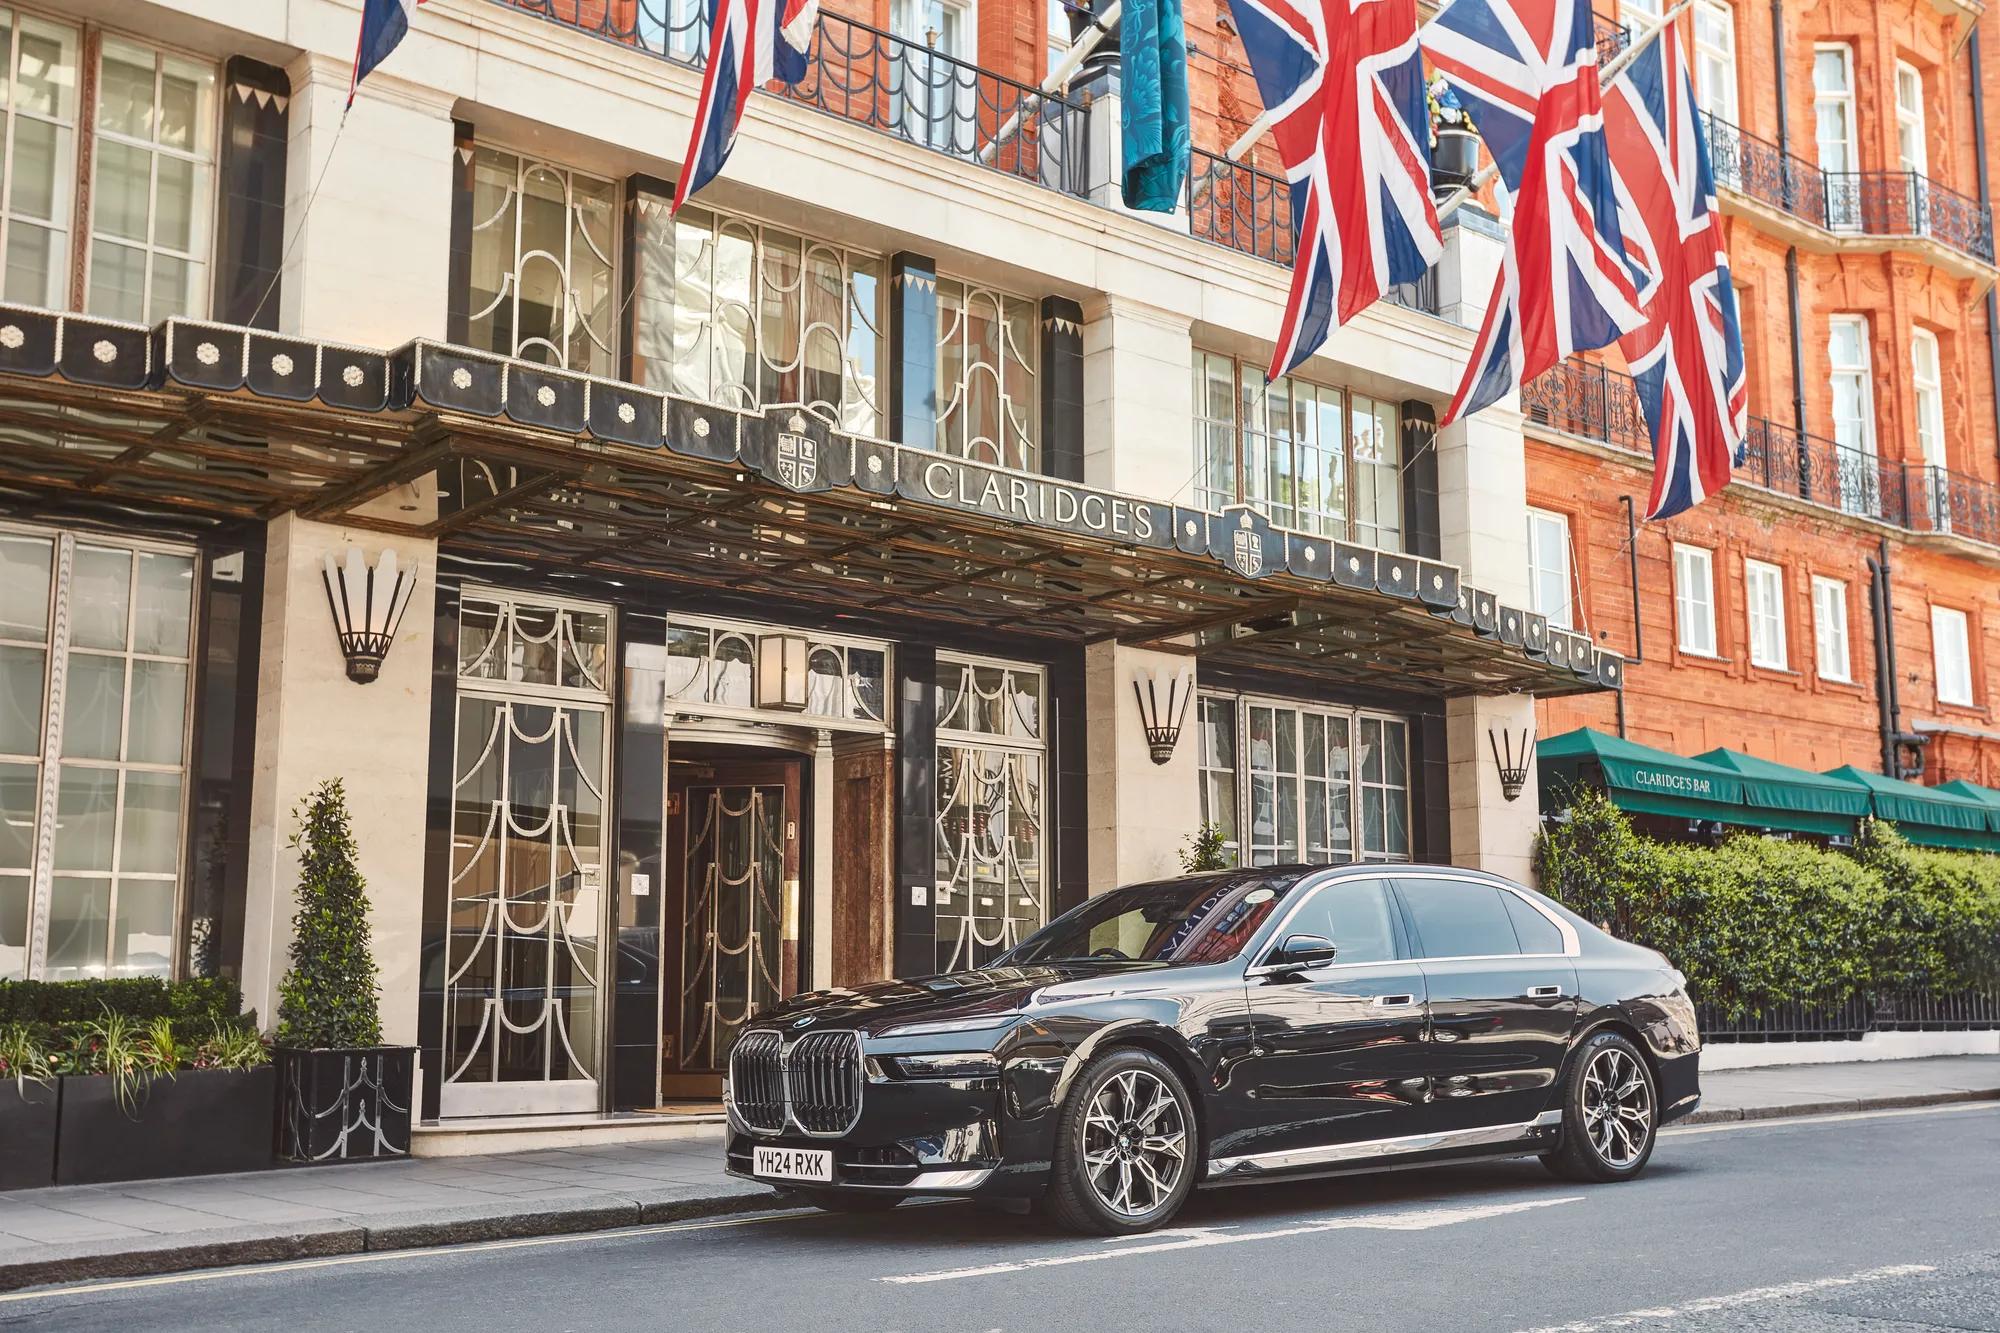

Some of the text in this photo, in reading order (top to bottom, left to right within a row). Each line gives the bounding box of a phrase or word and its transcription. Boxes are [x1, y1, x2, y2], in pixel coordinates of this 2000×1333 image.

[924, 462, 1152, 539] CLARIDGE'S
[1636, 771, 1710, 792] CLARIDGE'S BAR
[759, 1151, 824, 1176] YH24 RXK
